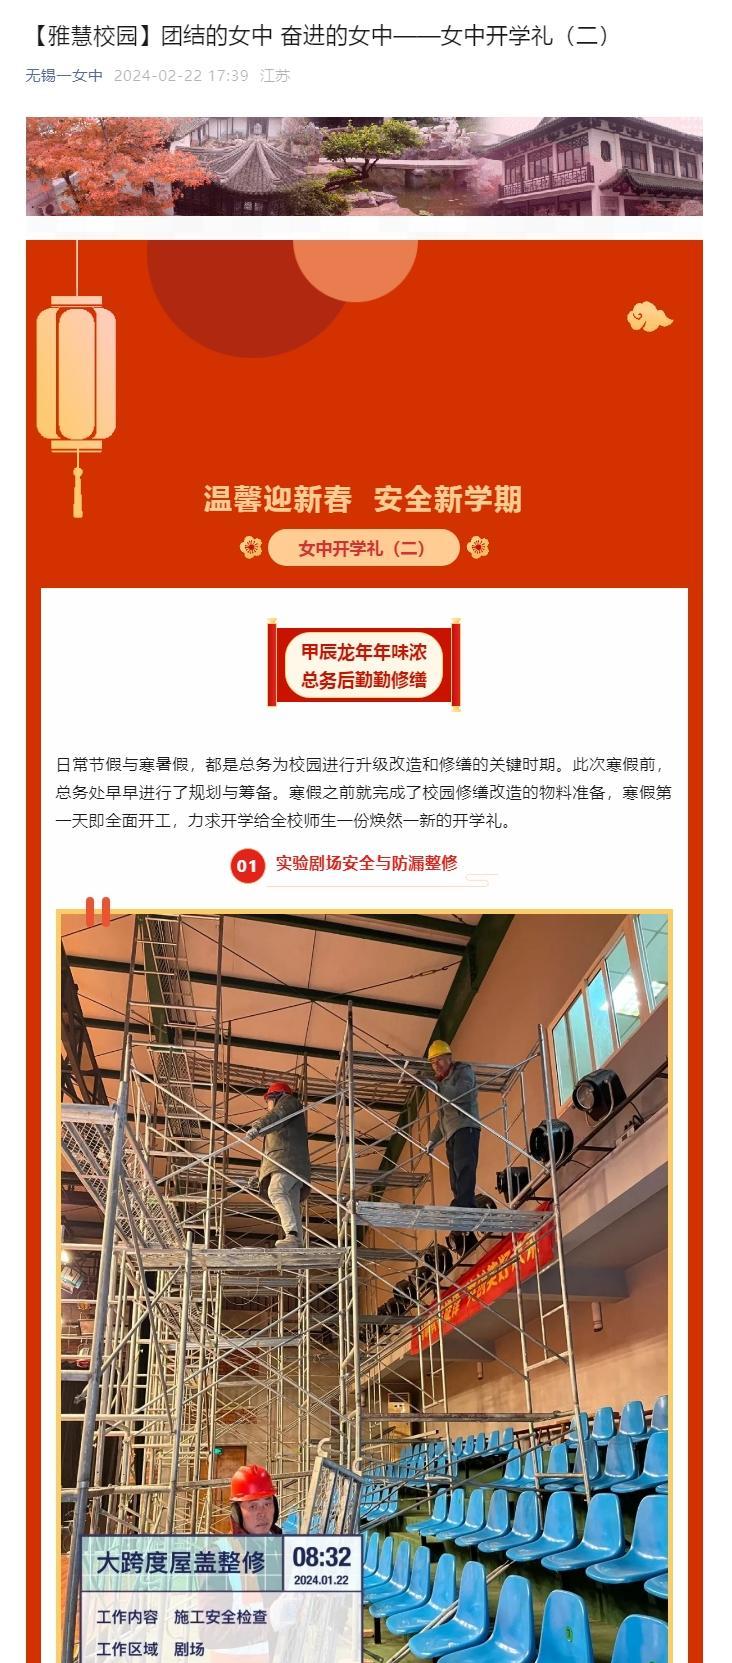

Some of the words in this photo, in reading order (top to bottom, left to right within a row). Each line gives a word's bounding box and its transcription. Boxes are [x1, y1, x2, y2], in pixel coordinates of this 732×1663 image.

[36, 24, 272, 47] 【雅慧校园】团结的女中
[281, 24, 606, 46] 奋进的女中——女中开学礼（二）
[26, 69, 102, 82] 无锡一女中
[115, 70, 201, 81] 2024-02-22
[211, 70, 248, 81] 17:39
[261, 69, 290, 82] 江苏
[204, 485, 352, 513] 温馨迎新春
[374, 485, 521, 513] 安全新学期
[299, 540, 424, 557] 女中开学礼（二）
[302, 643, 427, 662] 甲辰龙年年味浓
[301, 671, 427, 690] 总务后勤勤修缮
[58, 756, 661, 772] 日常节假与寒暑假，都是总务为校园进行升级改造和修缮的关键时期。此次寒假前，
[56, 784, 672, 800] 总务处早早进行了规划与筹备。寒假之前就完成了校园修缮改造的物料准备，寒假第
[56, 812, 508, 828] 一天即全面开工，力求开学给全校师生一份焕然一新的开学礼。
[237, 859, 258, 873] 01
[276, 855, 457, 871] 实验剧场安全与防漏整修
